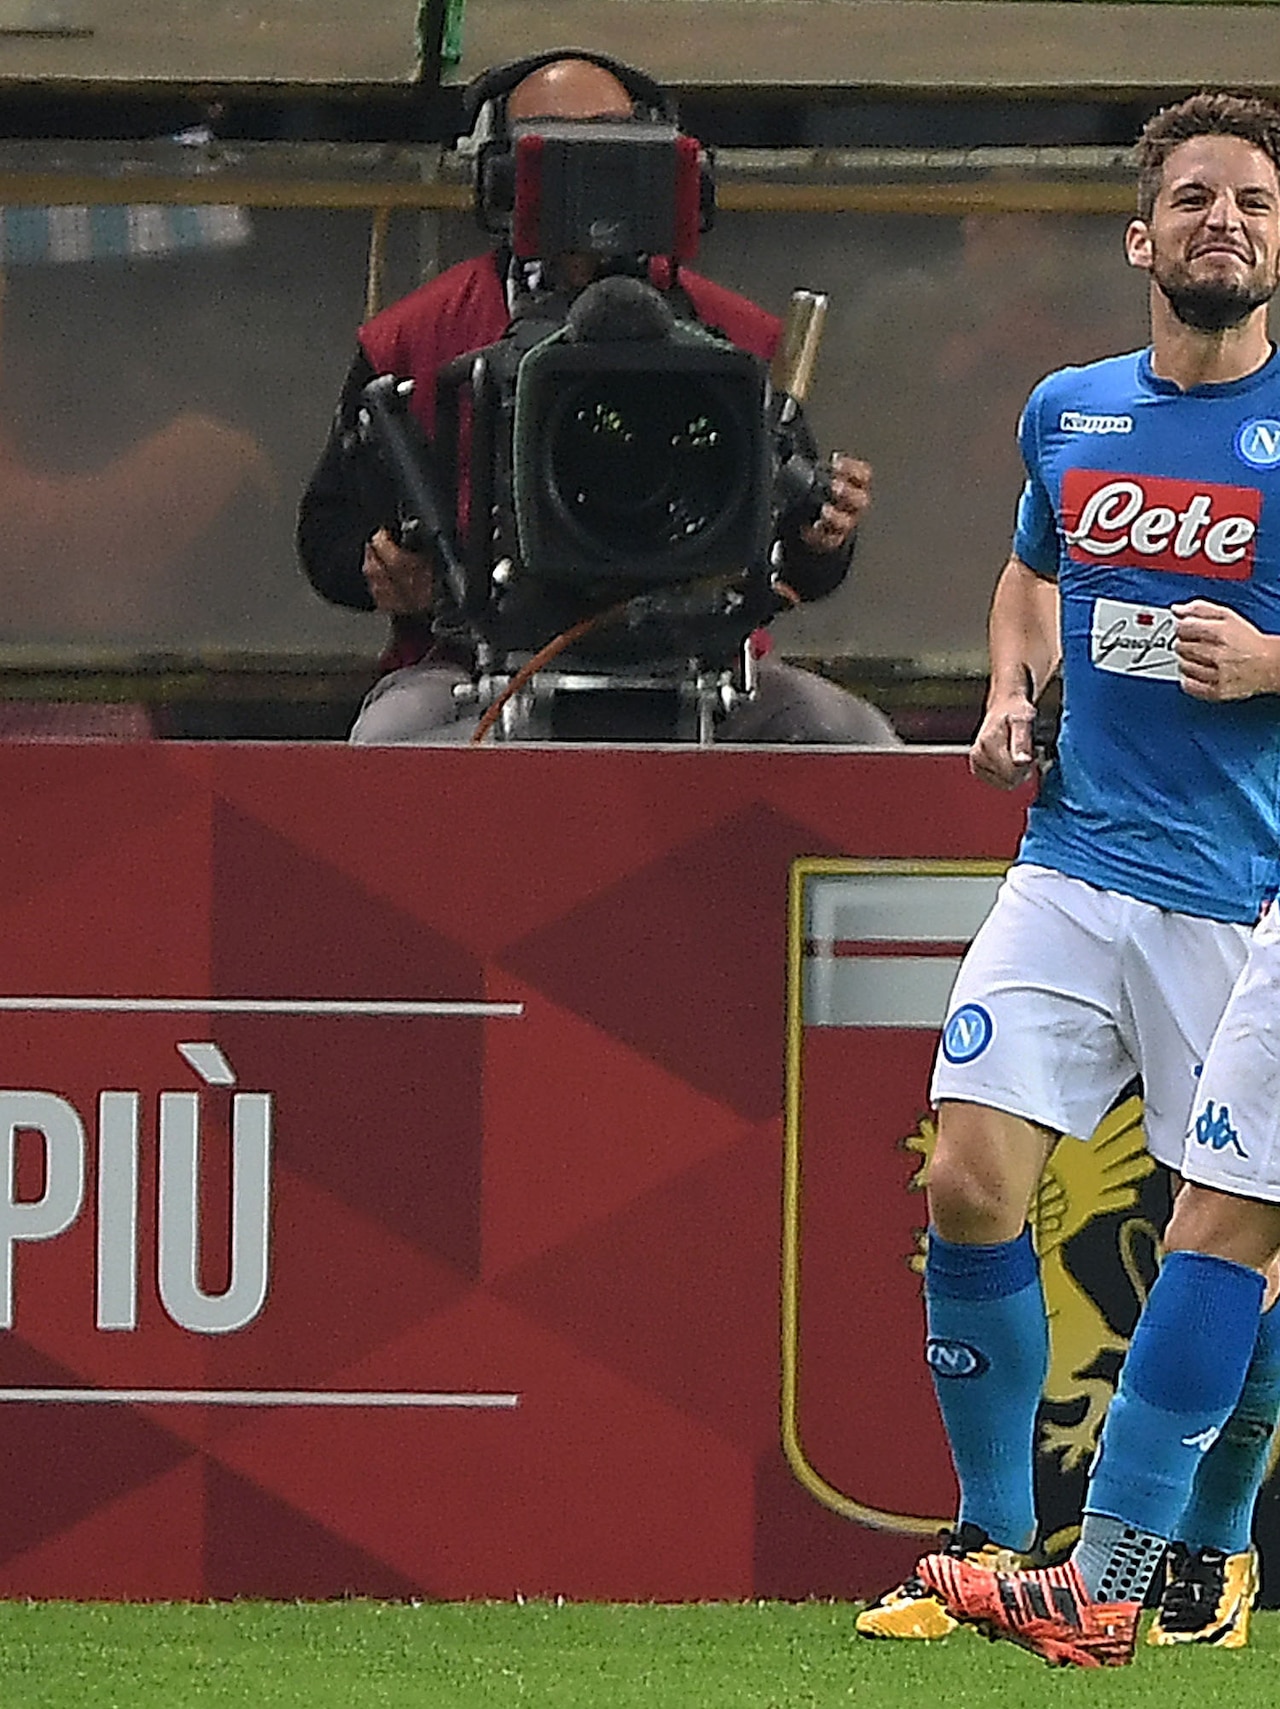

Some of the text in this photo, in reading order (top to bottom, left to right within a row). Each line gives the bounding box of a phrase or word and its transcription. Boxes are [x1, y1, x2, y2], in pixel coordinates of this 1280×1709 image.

[1062, 414, 1130, 432] Kappa
[1064, 481, 1256, 564] Lete
[1097, 619, 1178, 665] Garofal
[0, 1042, 273, 1333] PIÙ
